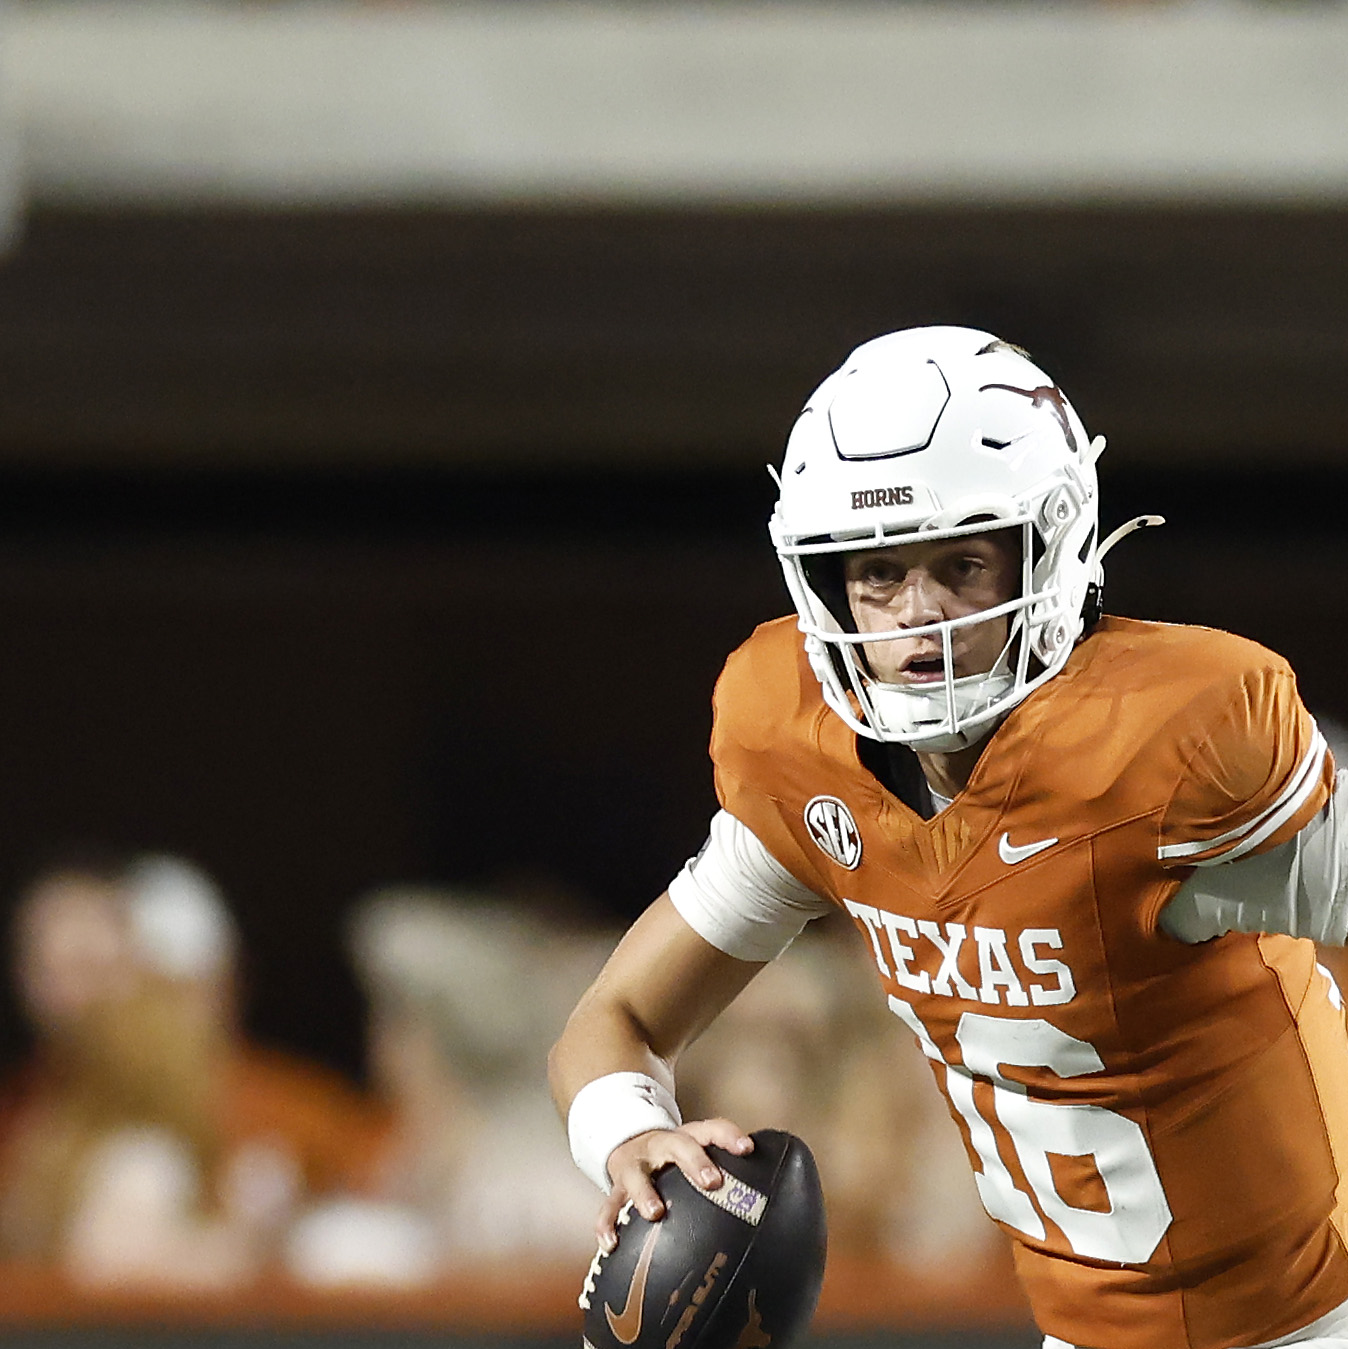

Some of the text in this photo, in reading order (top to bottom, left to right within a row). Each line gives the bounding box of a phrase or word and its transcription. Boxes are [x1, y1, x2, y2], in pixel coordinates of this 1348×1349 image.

[850, 485, 914, 510] HORNS
[807, 800, 858, 867] SEC
[842, 897, 1078, 1007] TEXAS
[887, 993, 1174, 1264] 16
